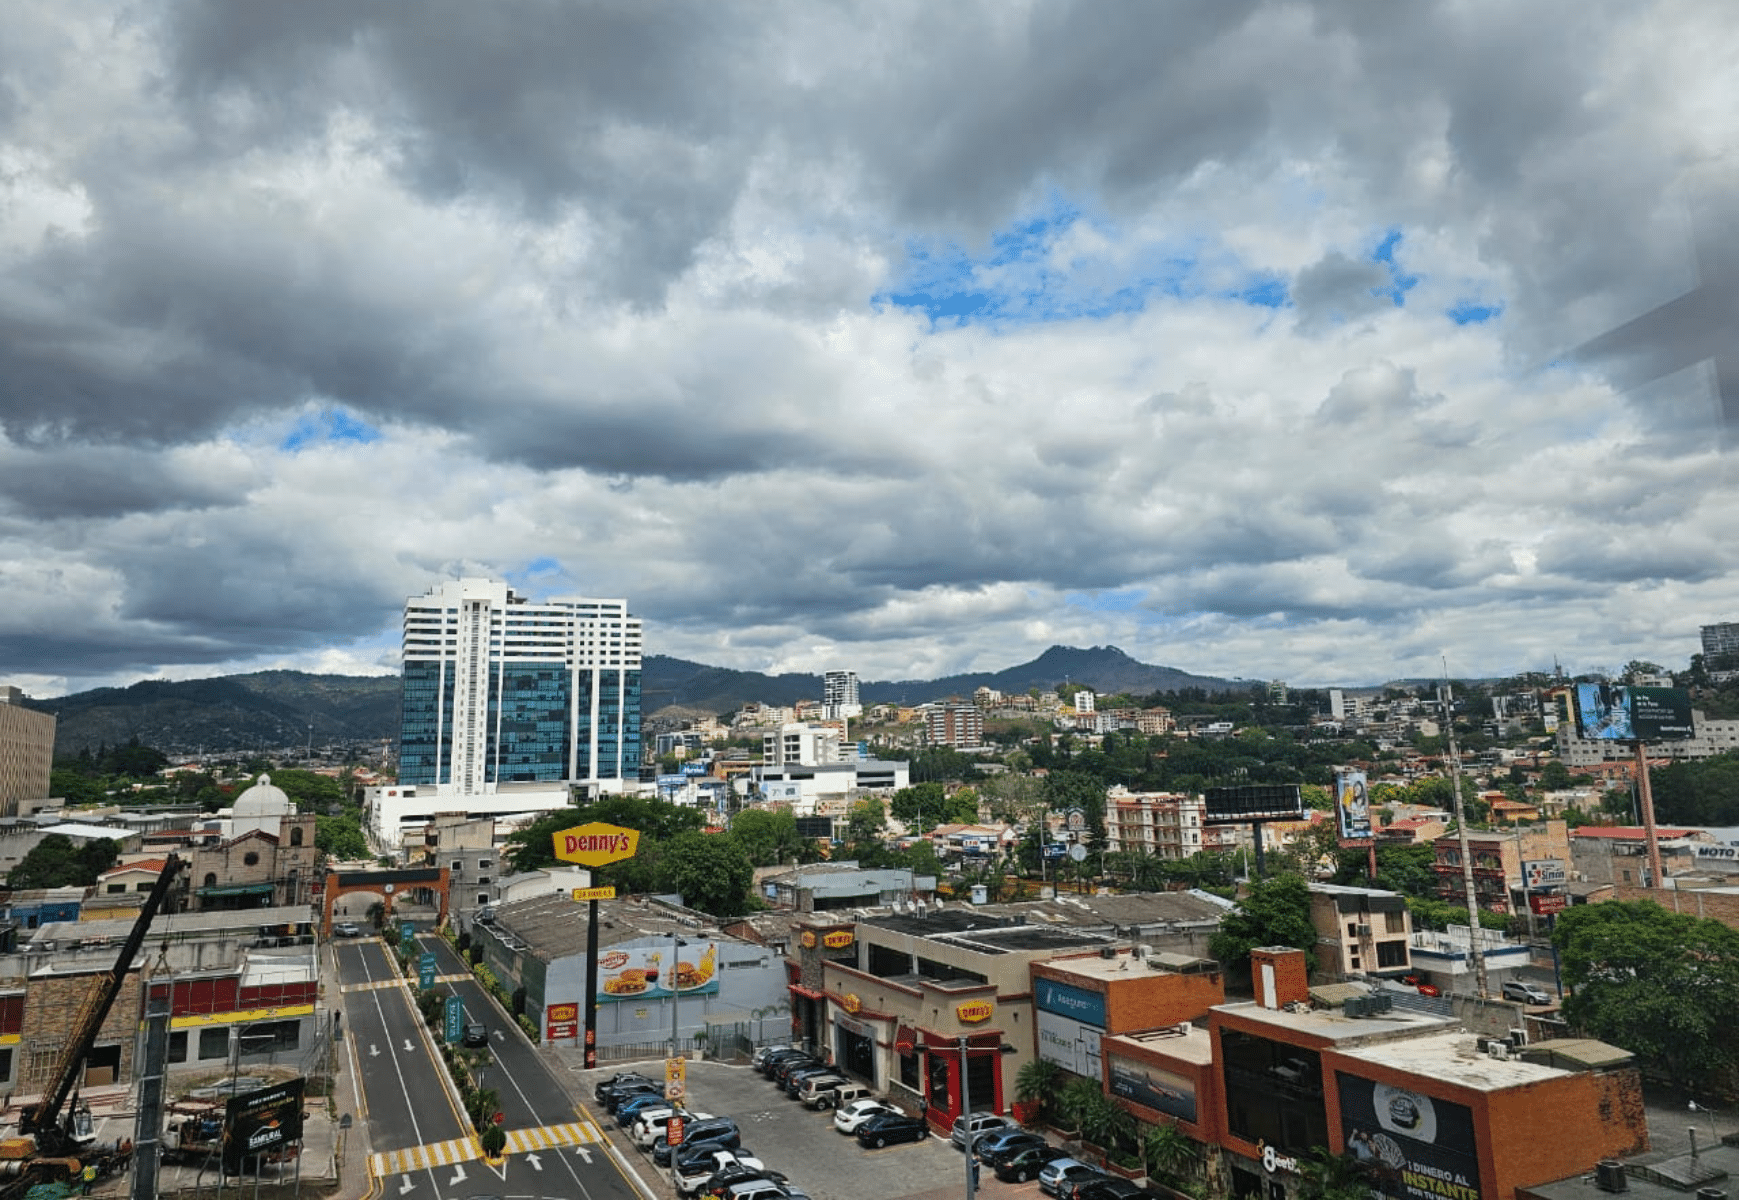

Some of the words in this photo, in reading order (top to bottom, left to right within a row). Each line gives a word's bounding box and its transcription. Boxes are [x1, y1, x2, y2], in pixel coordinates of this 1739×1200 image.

[565, 832, 630, 855] Denny's
[1698, 847, 1735, 857] MOTO
[1402, 1169, 1479, 1200] INSTANTE
[1455, 1173, 1471, 1187] AL
